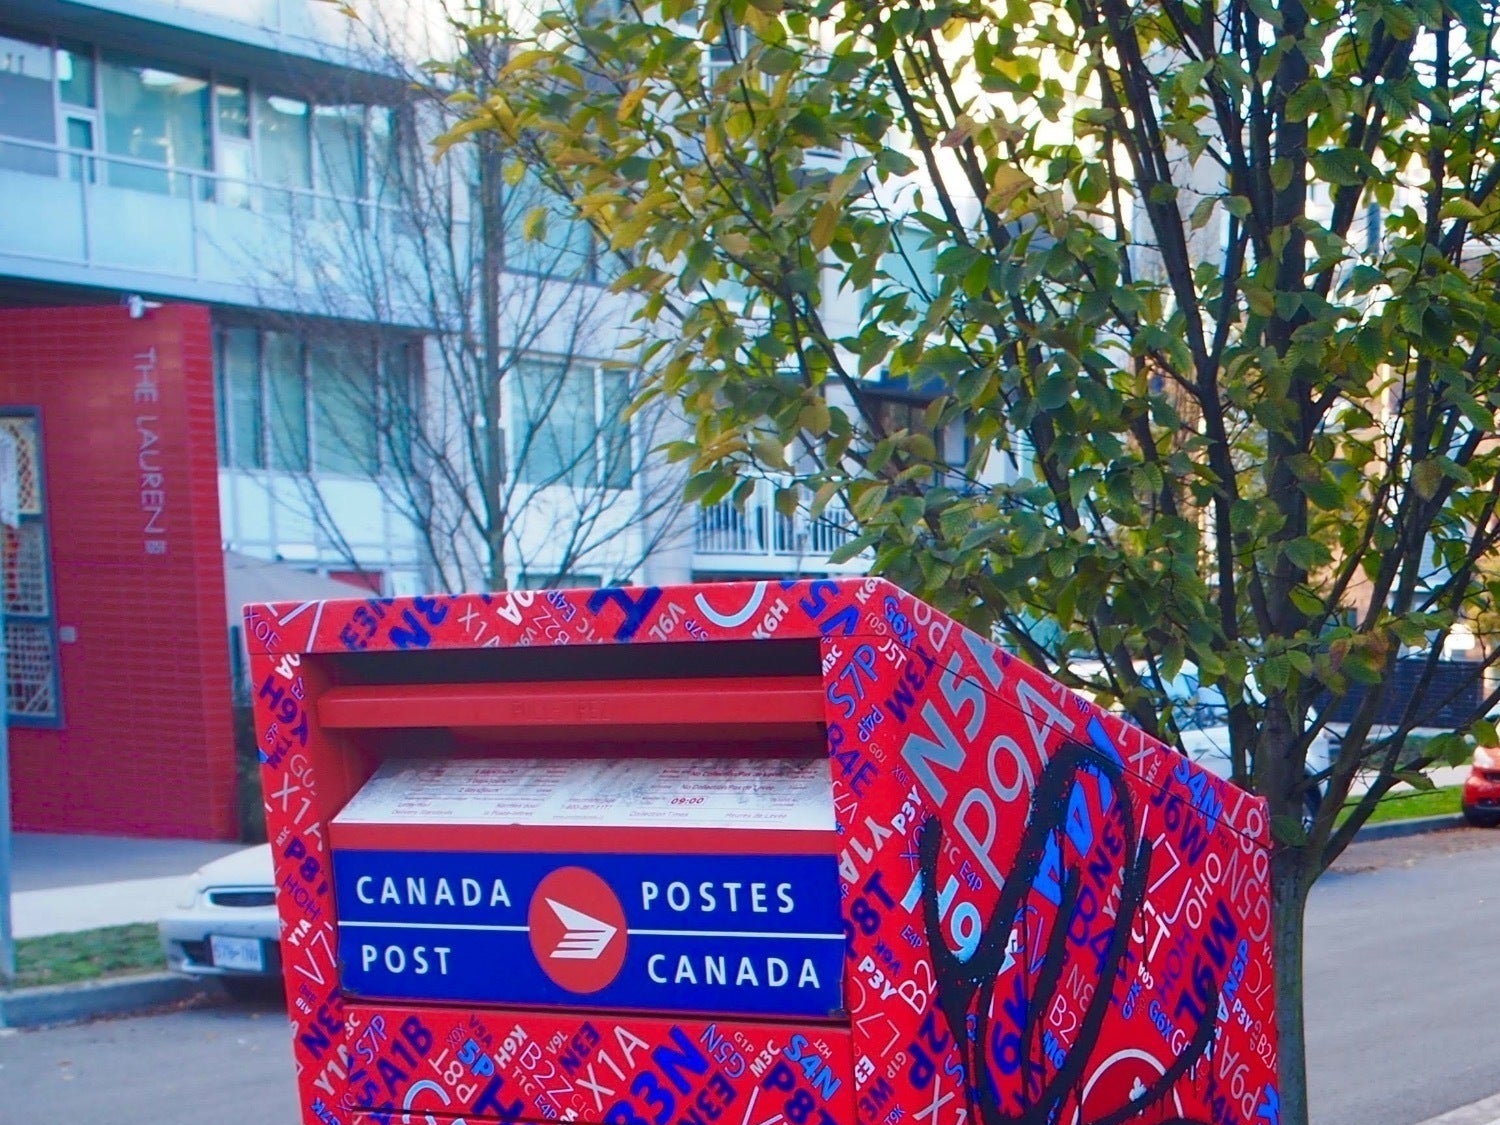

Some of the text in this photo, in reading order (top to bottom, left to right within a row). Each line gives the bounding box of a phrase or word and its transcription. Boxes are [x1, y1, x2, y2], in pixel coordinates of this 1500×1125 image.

[132, 346, 158, 403] THE
[884, 596, 918, 648] G6X
[827, 644, 878, 719] S7P
[885, 645, 937, 724] T3M
[829, 722, 879, 799] B4E
[670, 796, 705, 805] 09:00
[890, 785, 922, 836] P3Y
[840, 815, 893, 885] Y1A
[1223, 792, 1268, 884] P8T
[356, 875, 512, 908] CANADA
[641, 881, 797, 913] POSTES
[361, 944, 451, 975] POST
[646, 953, 822, 990] CANADA
[858, 955, 897, 1001] P3Y
[1224, 939, 1248, 1001] N5P
[377, 1015, 434, 1096] A1B
[428, 1048, 478, 1102] P8T
[519, 1041, 576, 1109] B2Z
[558, 1020, 600, 1076] E3N
[575, 1025, 651, 1112] X1A
[700, 1023, 747, 1078] G5N
[783, 1033, 842, 1101] S4N
[1220, 1037, 1263, 1120] P9A
